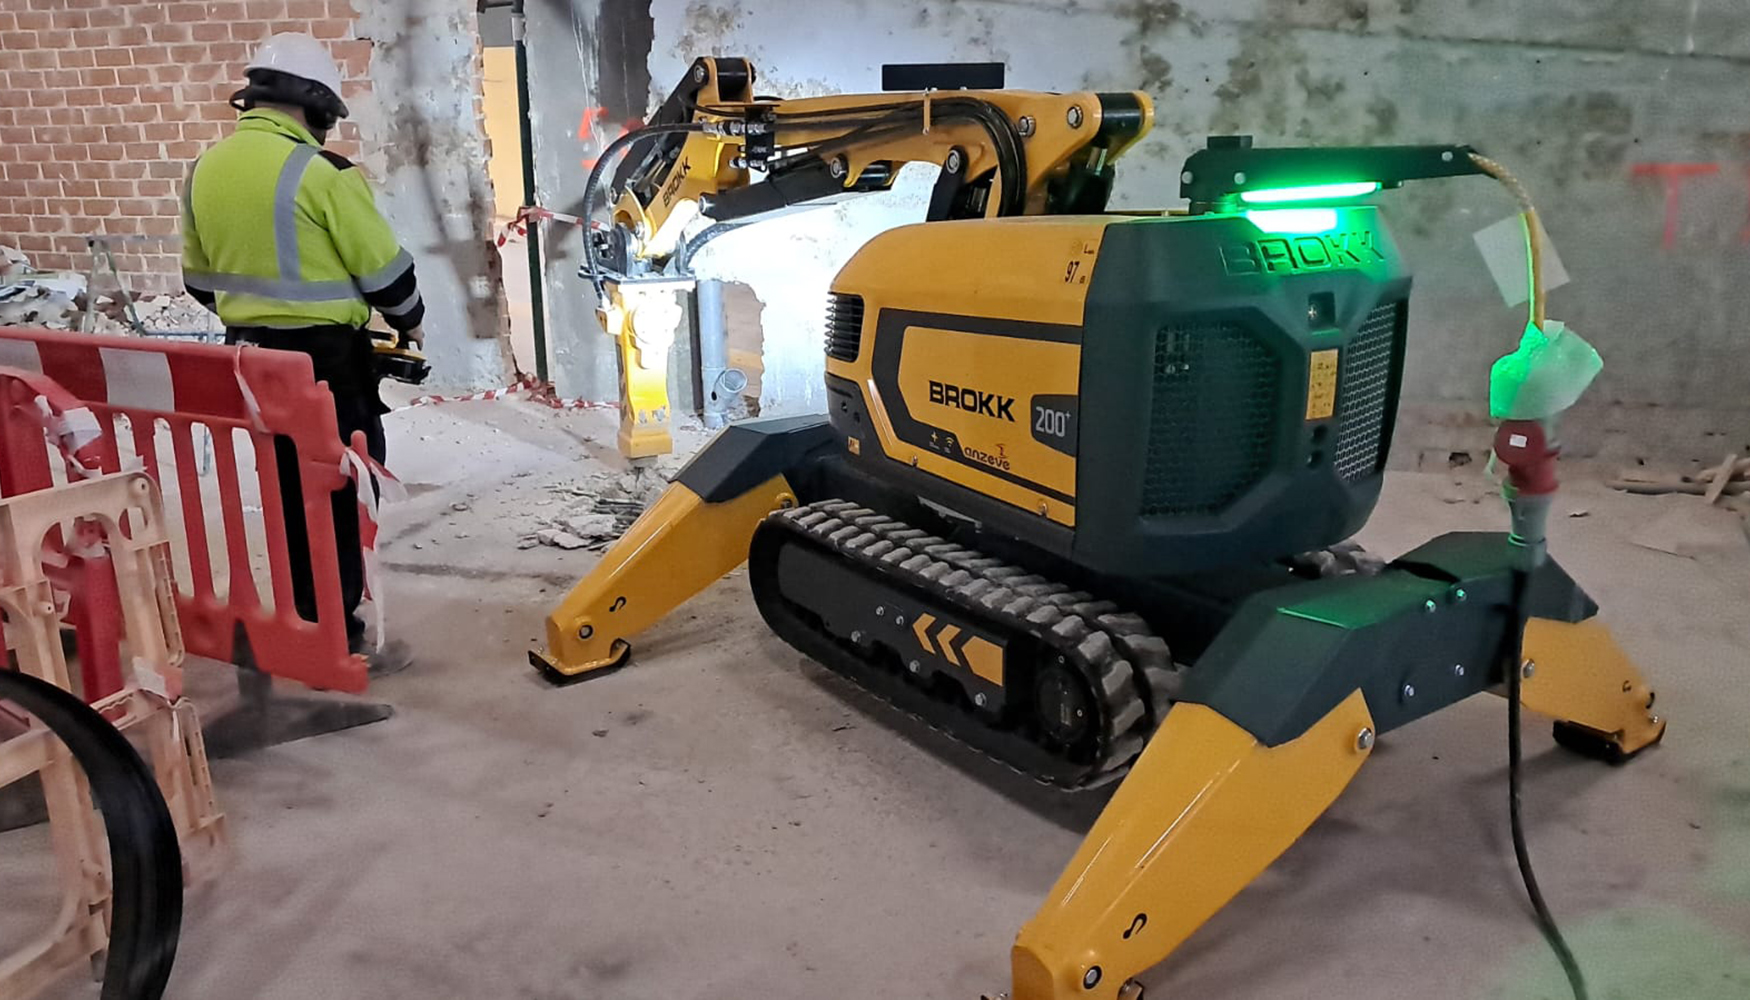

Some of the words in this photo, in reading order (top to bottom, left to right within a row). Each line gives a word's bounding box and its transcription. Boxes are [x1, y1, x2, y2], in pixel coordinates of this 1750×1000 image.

[663, 156, 691, 208] BROKK
[1065, 261, 1080, 283] 97
[929, 380, 1015, 422] BROKK
[964, 447, 1010, 470] anzeve
